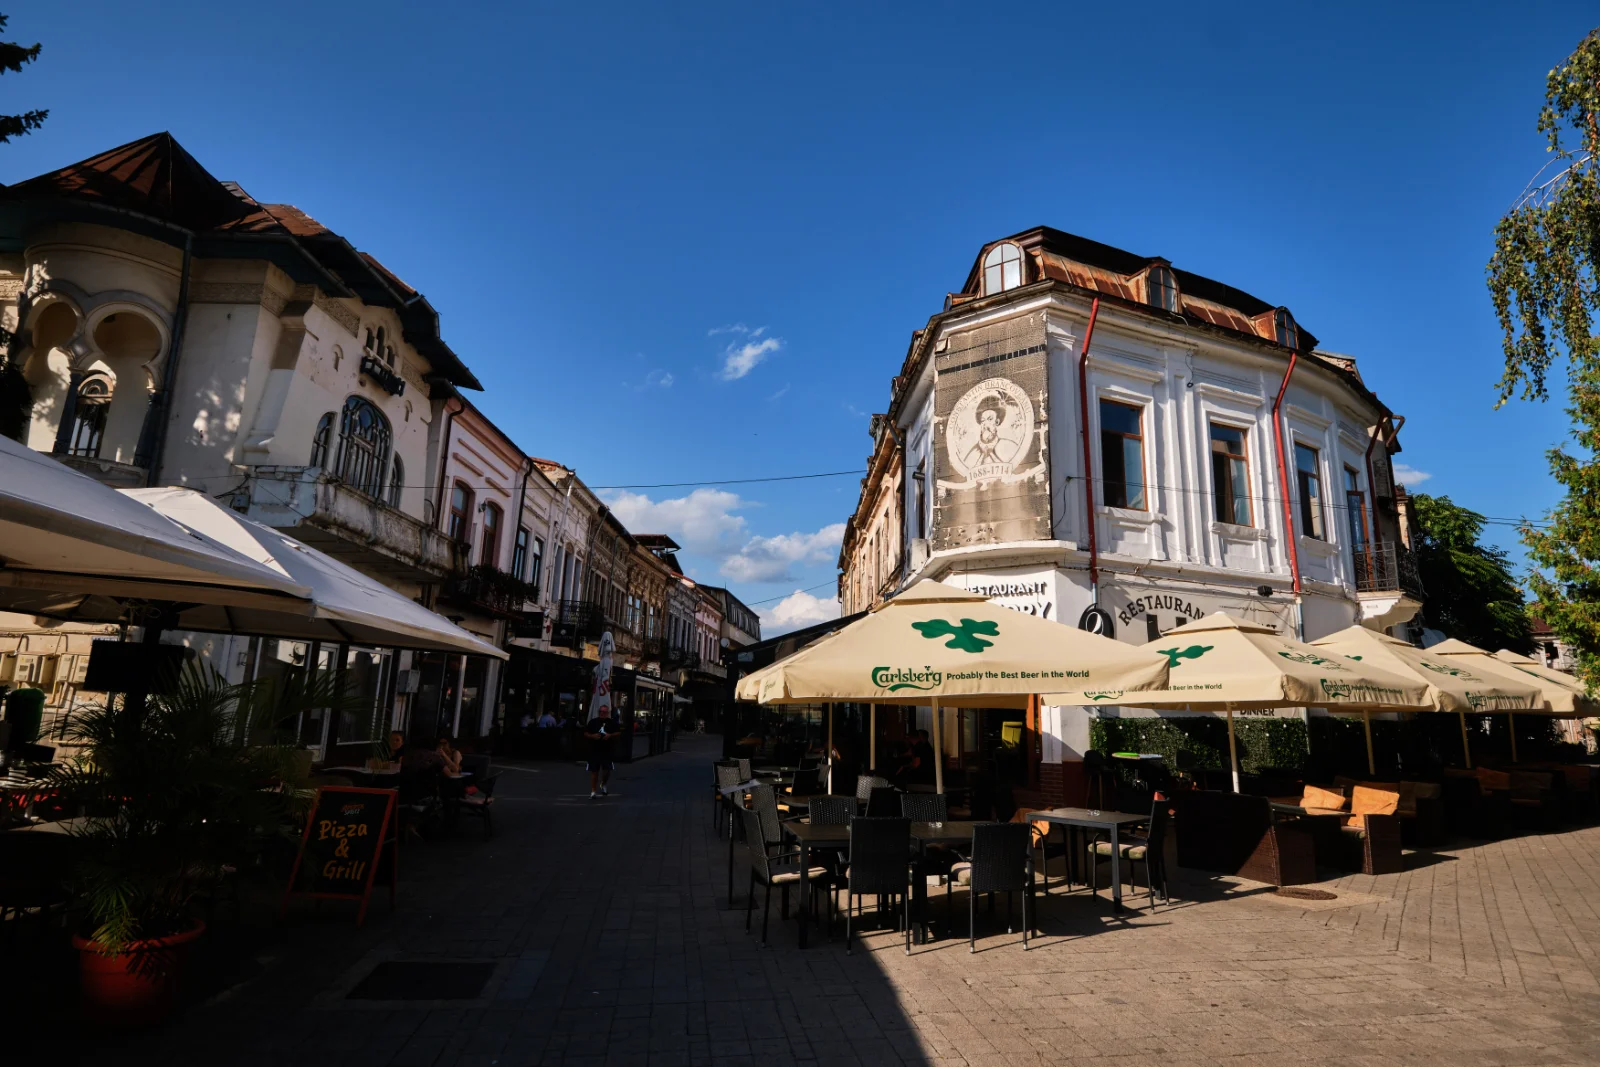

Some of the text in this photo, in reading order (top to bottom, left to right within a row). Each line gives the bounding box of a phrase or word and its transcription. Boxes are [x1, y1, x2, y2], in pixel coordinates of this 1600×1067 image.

[969, 464, 1010, 480] 1688-1714
[965, 581, 1048, 598] ESTAURANT
[1118, 595, 1206, 627] RESTAURAN
[871, 665, 1090, 693] Carlsberg Probably the Best Beer in the World
[1204, 682, 1222, 690] World
[1240, 708, 1275, 717] DINNER
[318, 819, 369, 841] Pizza
[335, 837, 351, 859] &
[322, 859, 367, 881] Grill
